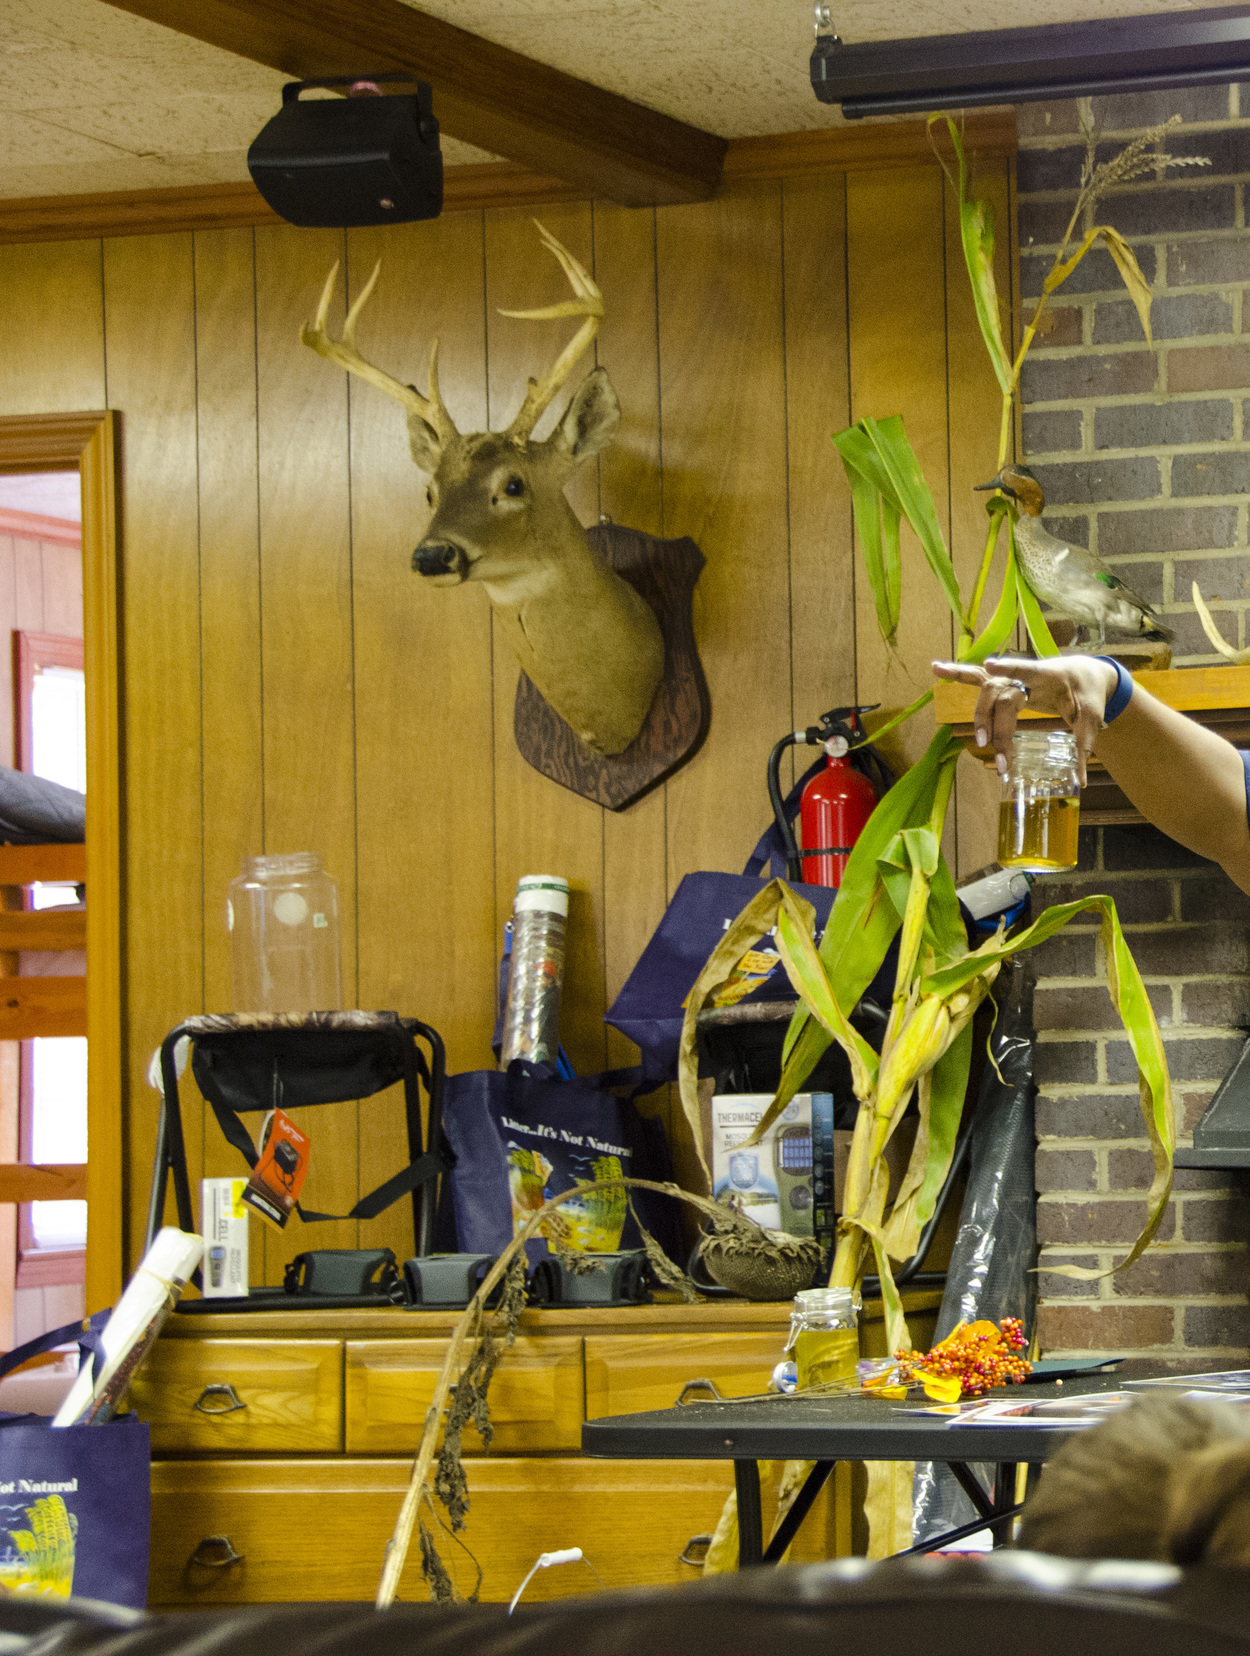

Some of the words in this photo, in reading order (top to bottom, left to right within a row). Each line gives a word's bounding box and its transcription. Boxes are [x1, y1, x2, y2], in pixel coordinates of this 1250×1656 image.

[559, 1129, 584, 1147] Not
[0, 1480, 16, 1494] ot
[18, 1478, 78, 1493] Natural
